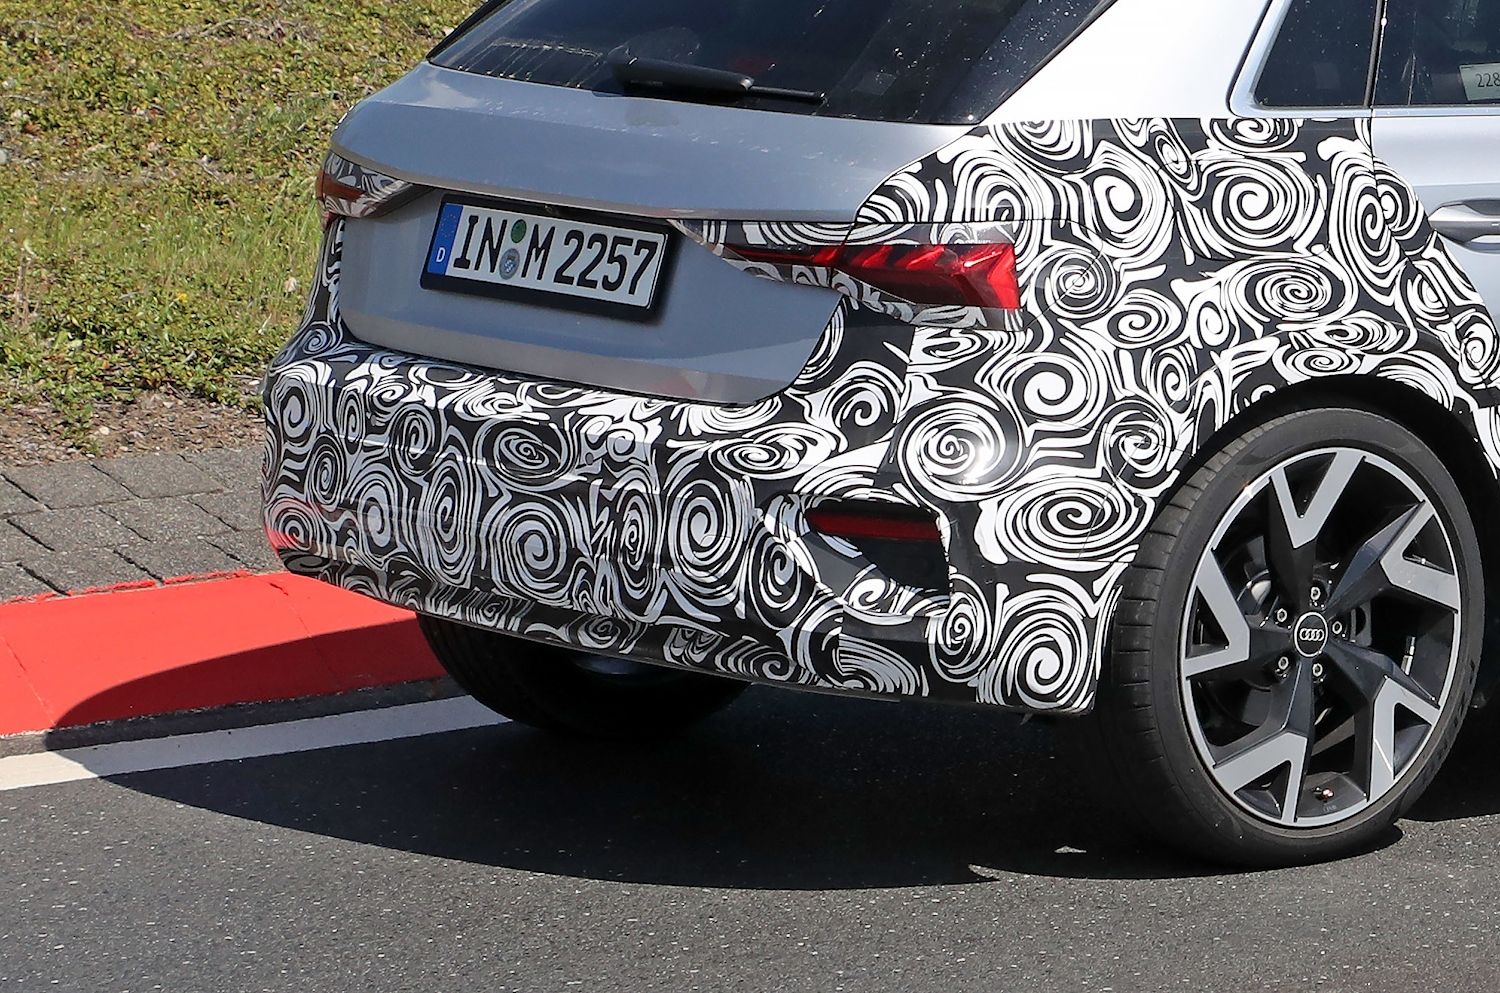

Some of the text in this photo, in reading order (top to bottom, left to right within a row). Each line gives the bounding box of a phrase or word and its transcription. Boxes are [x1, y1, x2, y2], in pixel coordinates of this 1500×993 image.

[436, 246, 446, 263] D
[453, 215, 659, 295] IN M 2257
